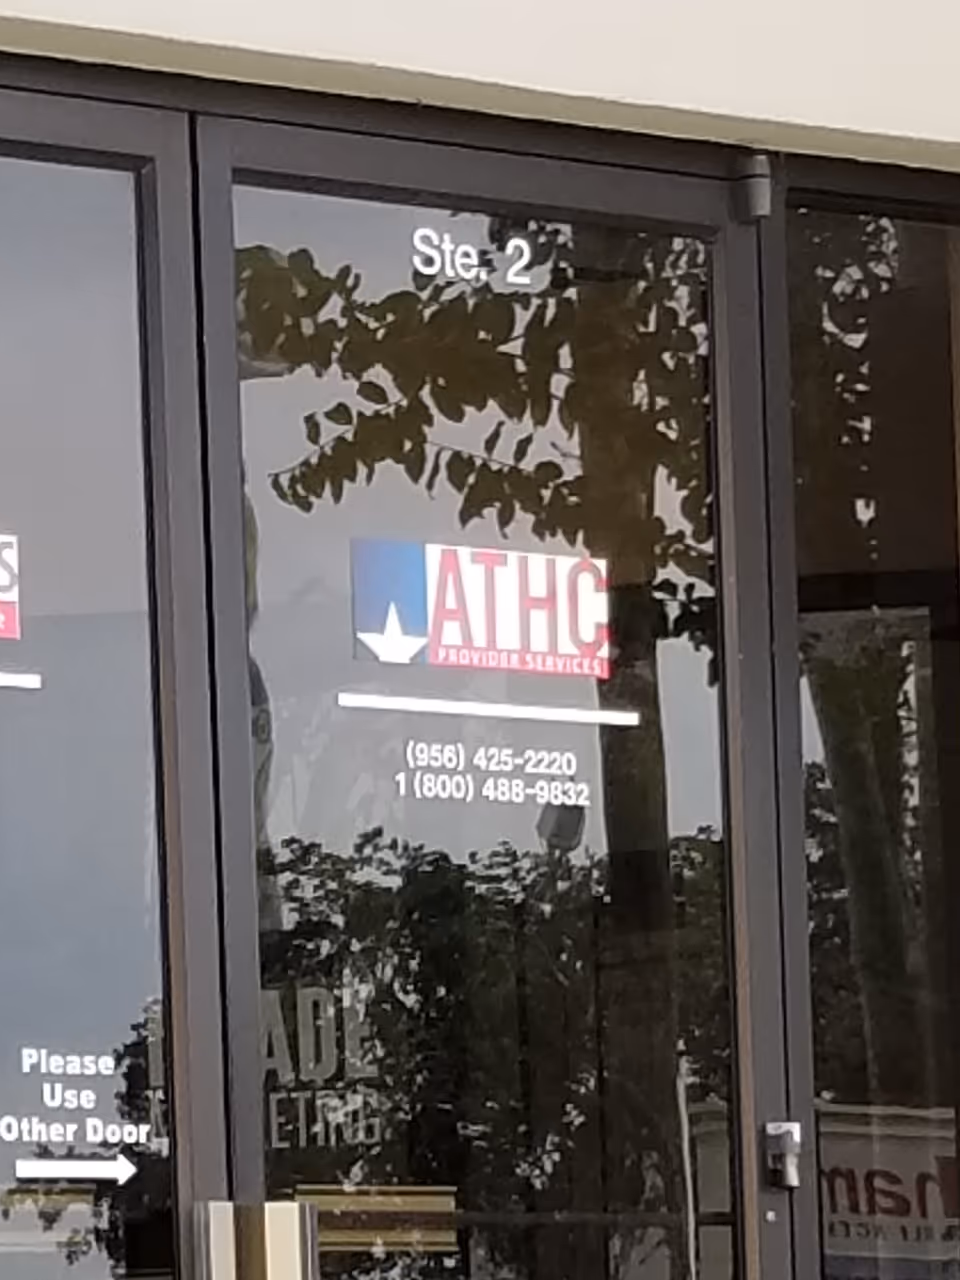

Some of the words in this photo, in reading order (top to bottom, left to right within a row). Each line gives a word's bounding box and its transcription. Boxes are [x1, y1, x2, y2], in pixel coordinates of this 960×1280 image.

[412, 227, 488, 280] Ste.
[505, 237, 531, 285] 2
[429, 548, 610, 657] ATHC
[438, 646, 521, 668] PROVIDER
[526, 653, 601, 675] SERVICES
[406, 740, 465, 771] (956)
[473, 746, 577, 775] 425-2220
[395, 773, 406, 796] 1
[414, 771, 474, 802] (800)
[482, 777, 591, 806] 488-9832
[21, 1047, 116, 1075] Please
[43, 1082, 97, 1109] Use
[85, 1117, 151, 1144] Door
